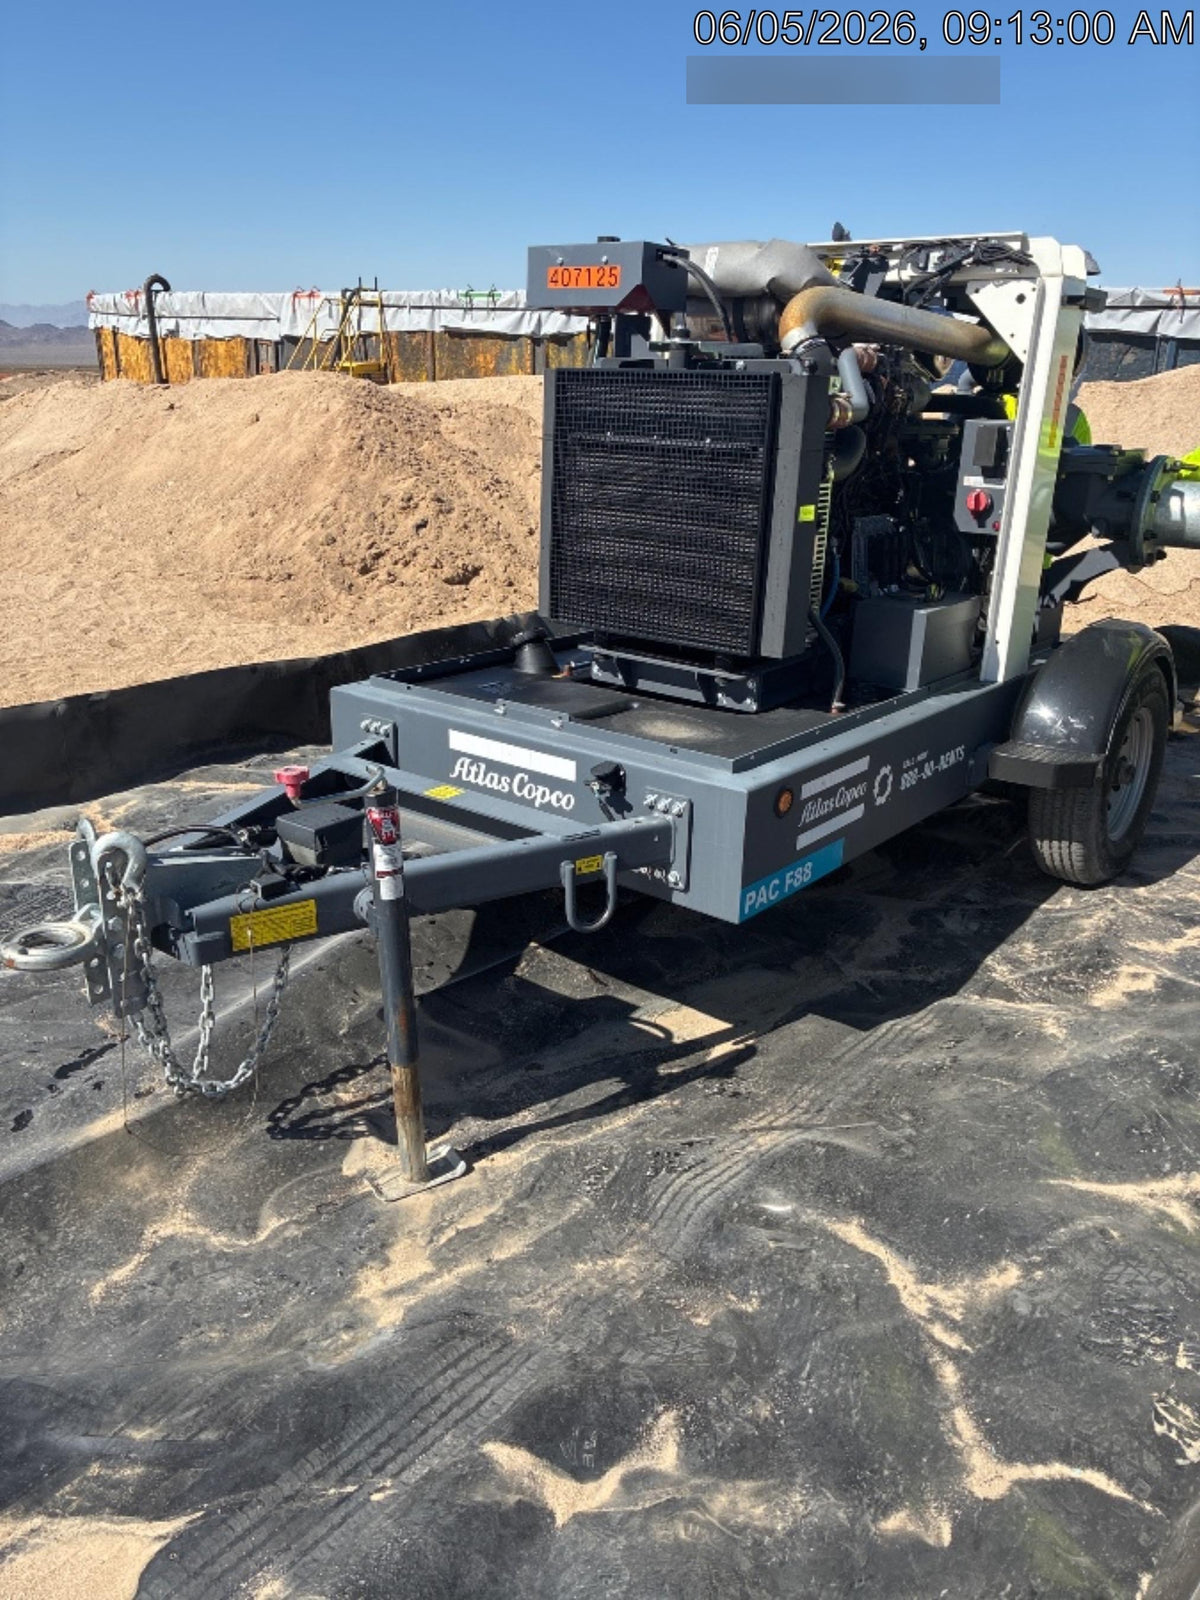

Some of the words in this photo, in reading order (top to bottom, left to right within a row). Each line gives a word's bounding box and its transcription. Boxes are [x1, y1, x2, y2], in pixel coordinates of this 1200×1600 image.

[549, 267, 619, 288] 407125
[450, 756, 511, 793] Atlas
[512, 773, 575, 811] Copco
[744, 878, 780, 914] PAC
[784, 861, 813, 892] F88
